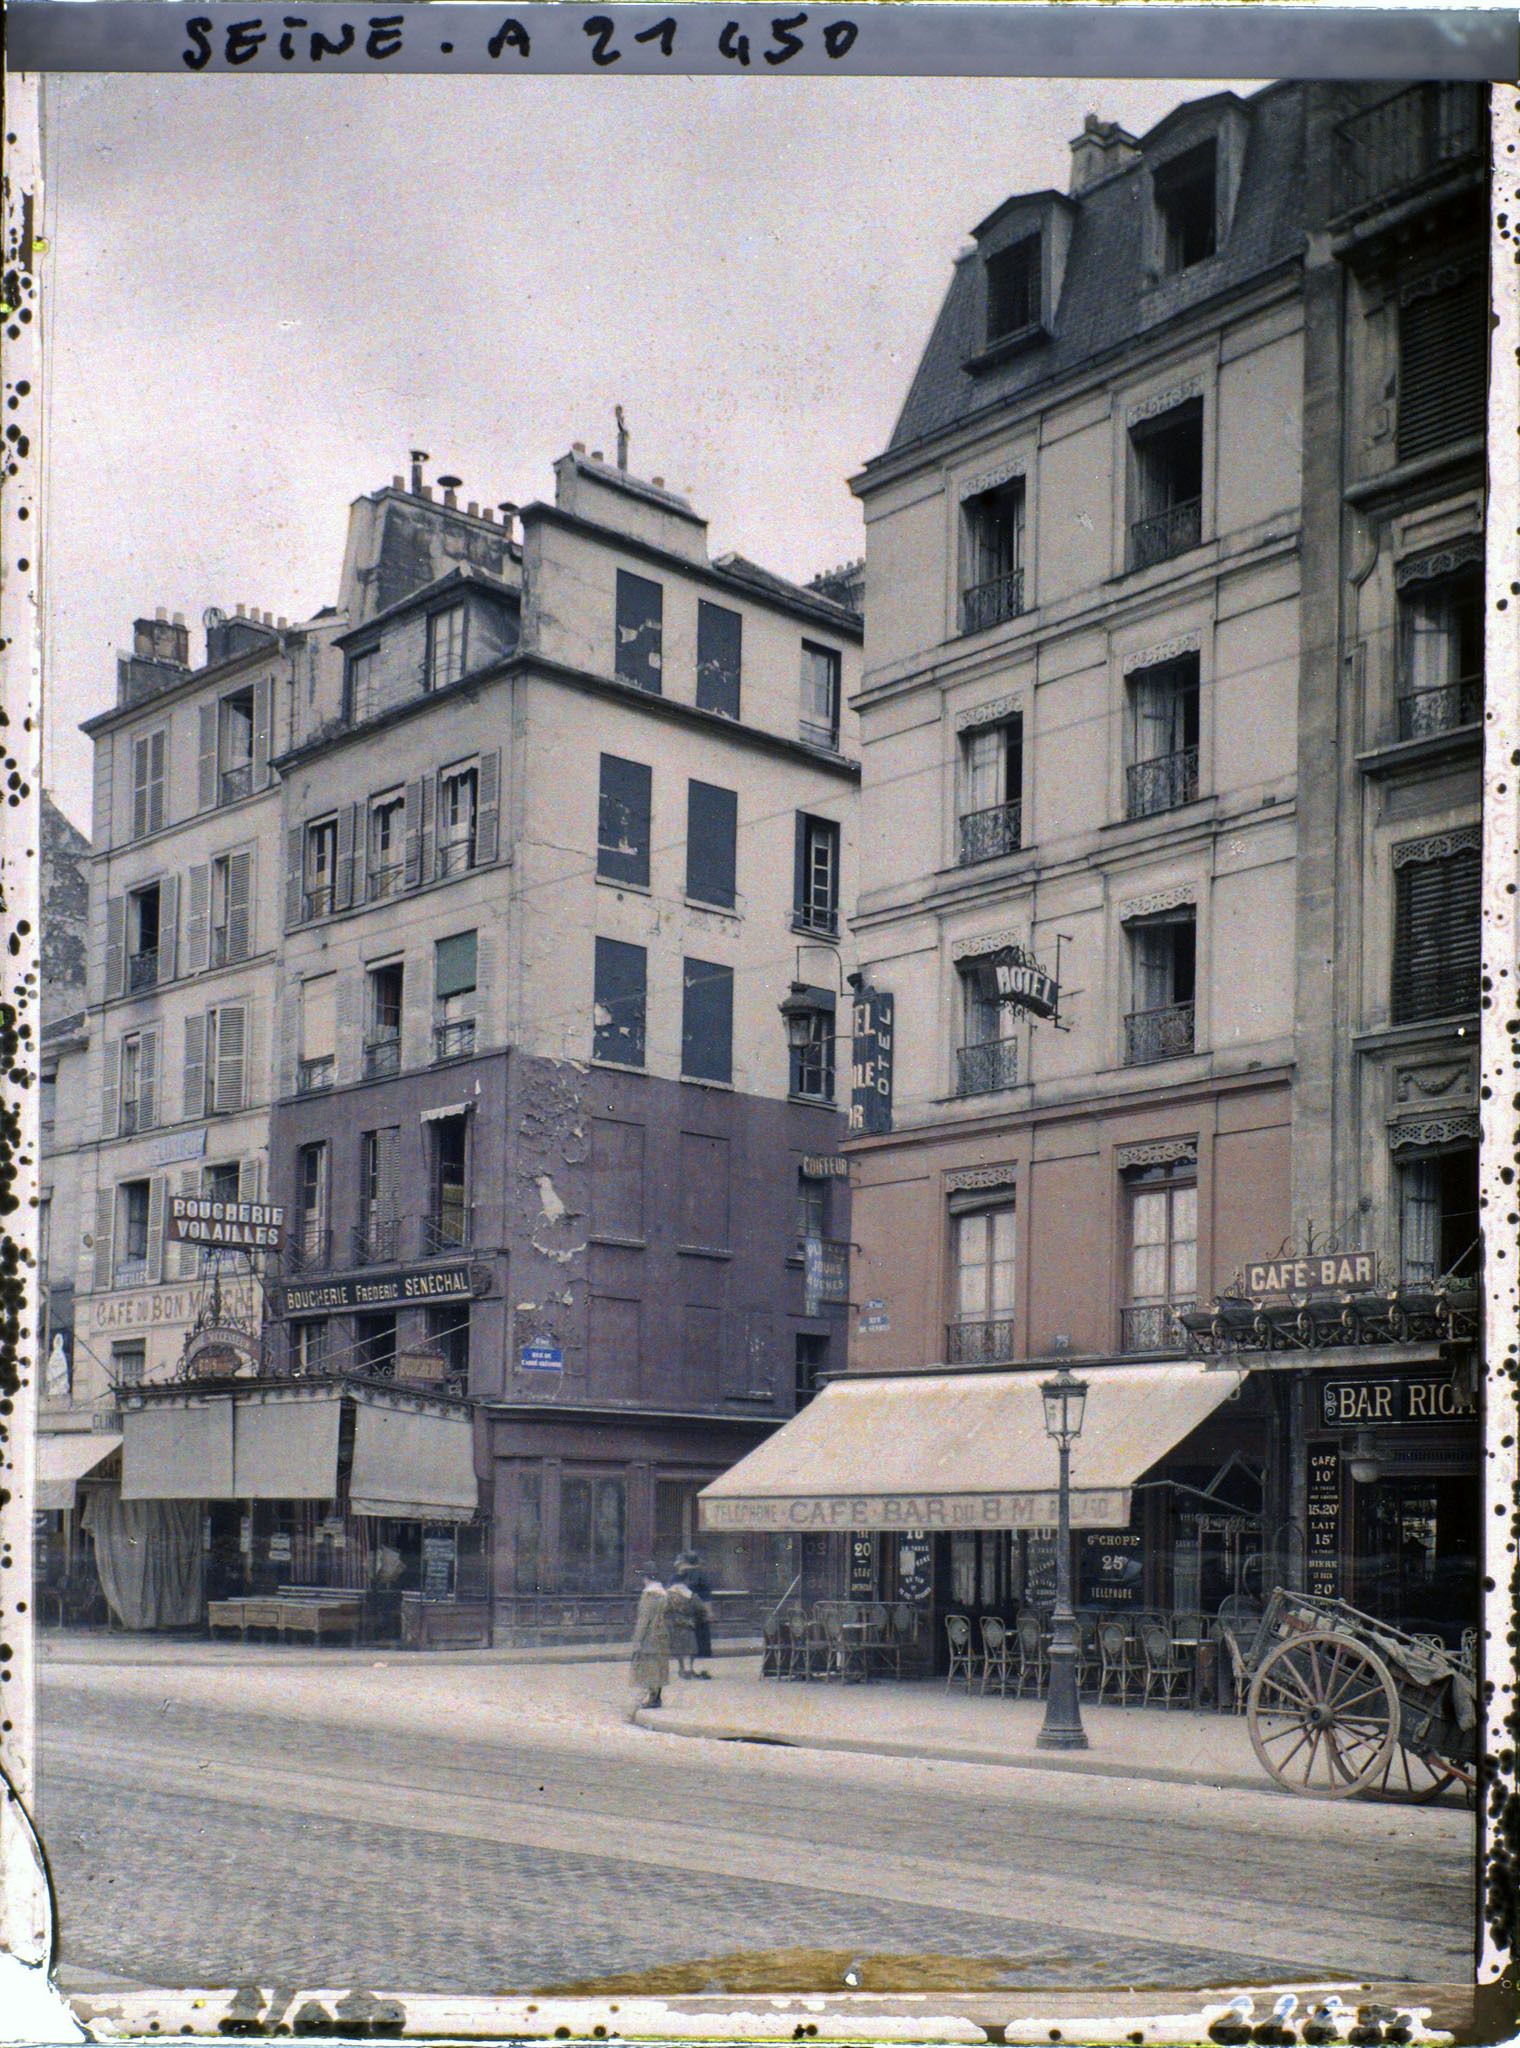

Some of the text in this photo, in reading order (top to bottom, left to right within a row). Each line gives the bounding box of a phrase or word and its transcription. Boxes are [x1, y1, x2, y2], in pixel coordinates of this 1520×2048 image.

[487, 17, 531, 58] A
[589, 17, 674, 66] 21
[718, 15, 859, 67] 450
[803, 1156, 848, 1177] COIFFEUR
[173, 1199, 284, 1226] BOUCHERIE
[176, 1220, 279, 1246] VOLAILLES
[287, 1287, 349, 1309] BOUCHERIE
[1339, 1386, 1393, 1418] BAR
[1311, 1455, 1337, 1467] CAFÉ
[884, 1499, 945, 1524] BAR
[1311, 1522, 1336, 1530] LAIT
[854, 1542, 871, 1557] 20
[1099, 1534, 1138, 1546] CHOPE
